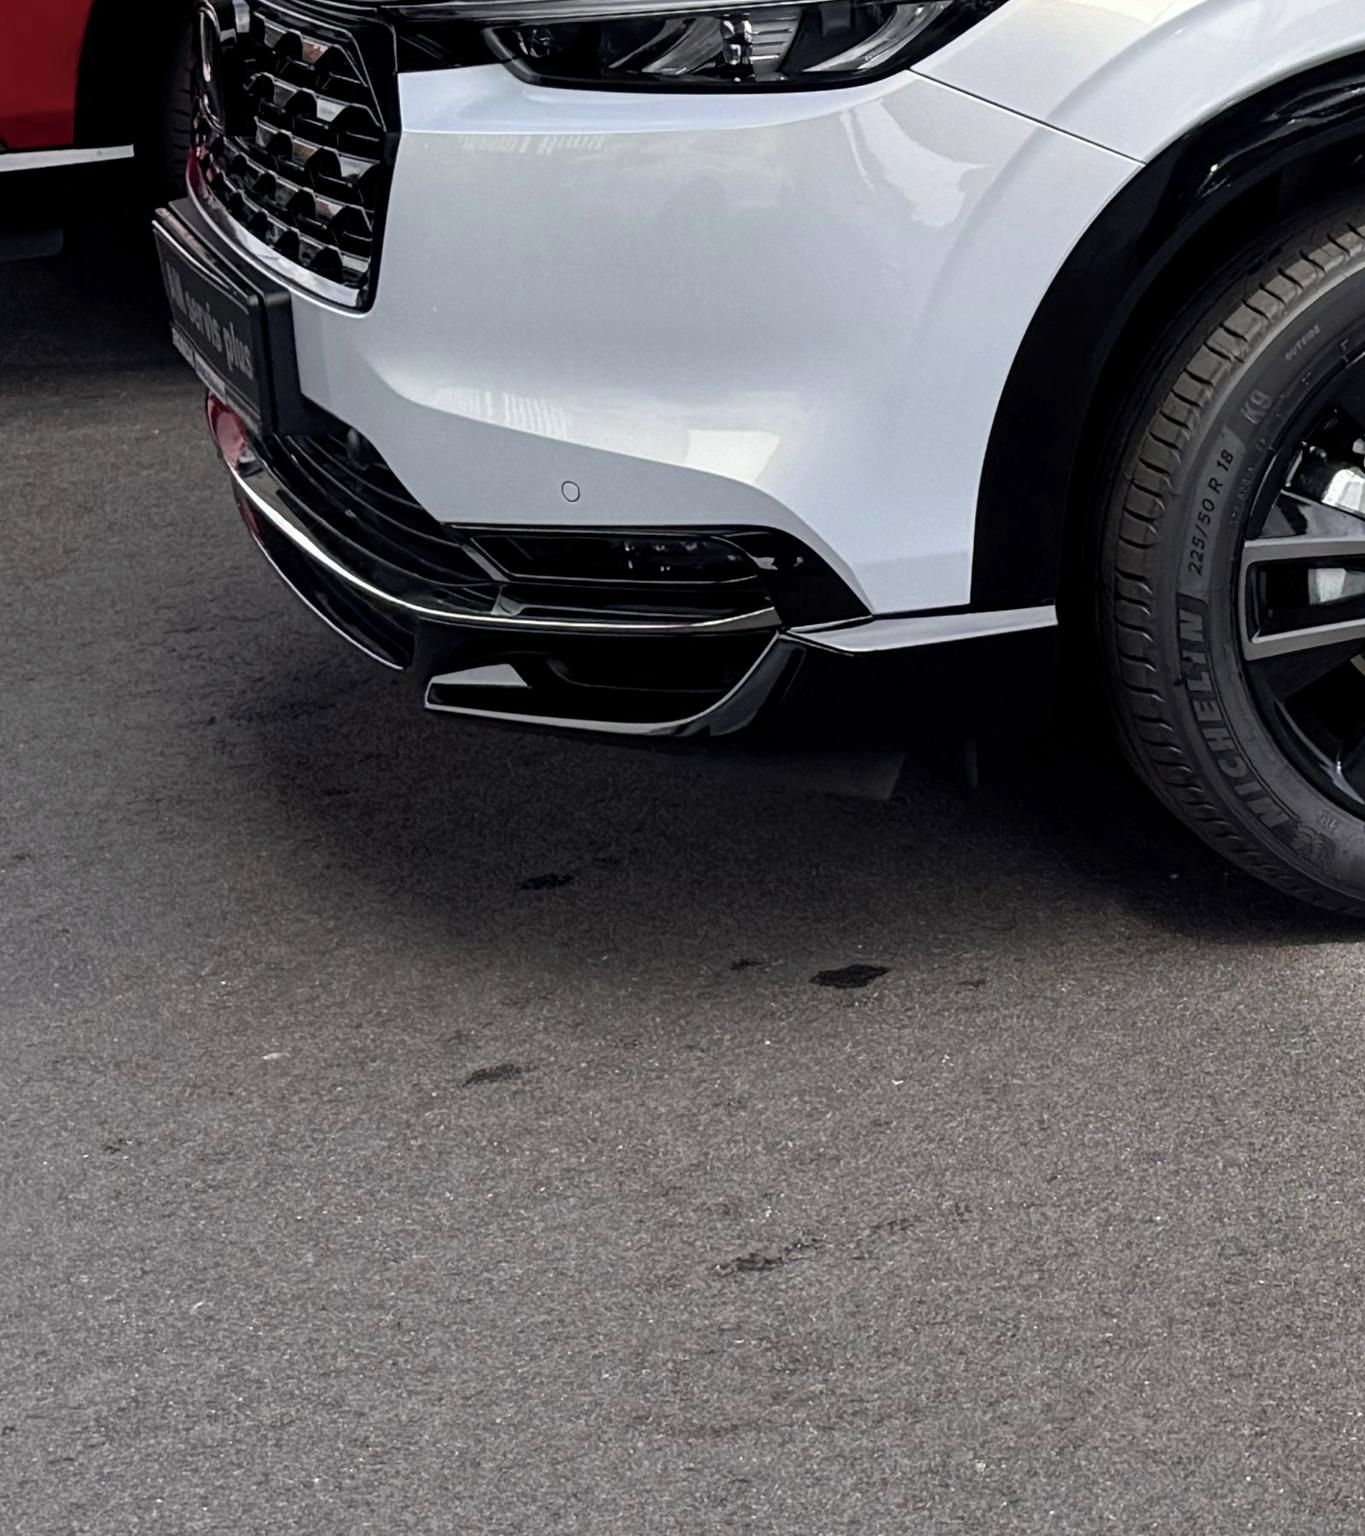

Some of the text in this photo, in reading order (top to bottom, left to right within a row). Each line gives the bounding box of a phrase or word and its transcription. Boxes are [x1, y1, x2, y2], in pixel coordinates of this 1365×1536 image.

[223, 322, 254, 380] plus
[1188, 449, 1235, 577] 225/50 R 18
[1179, 609, 1291, 830] MICHELIN
